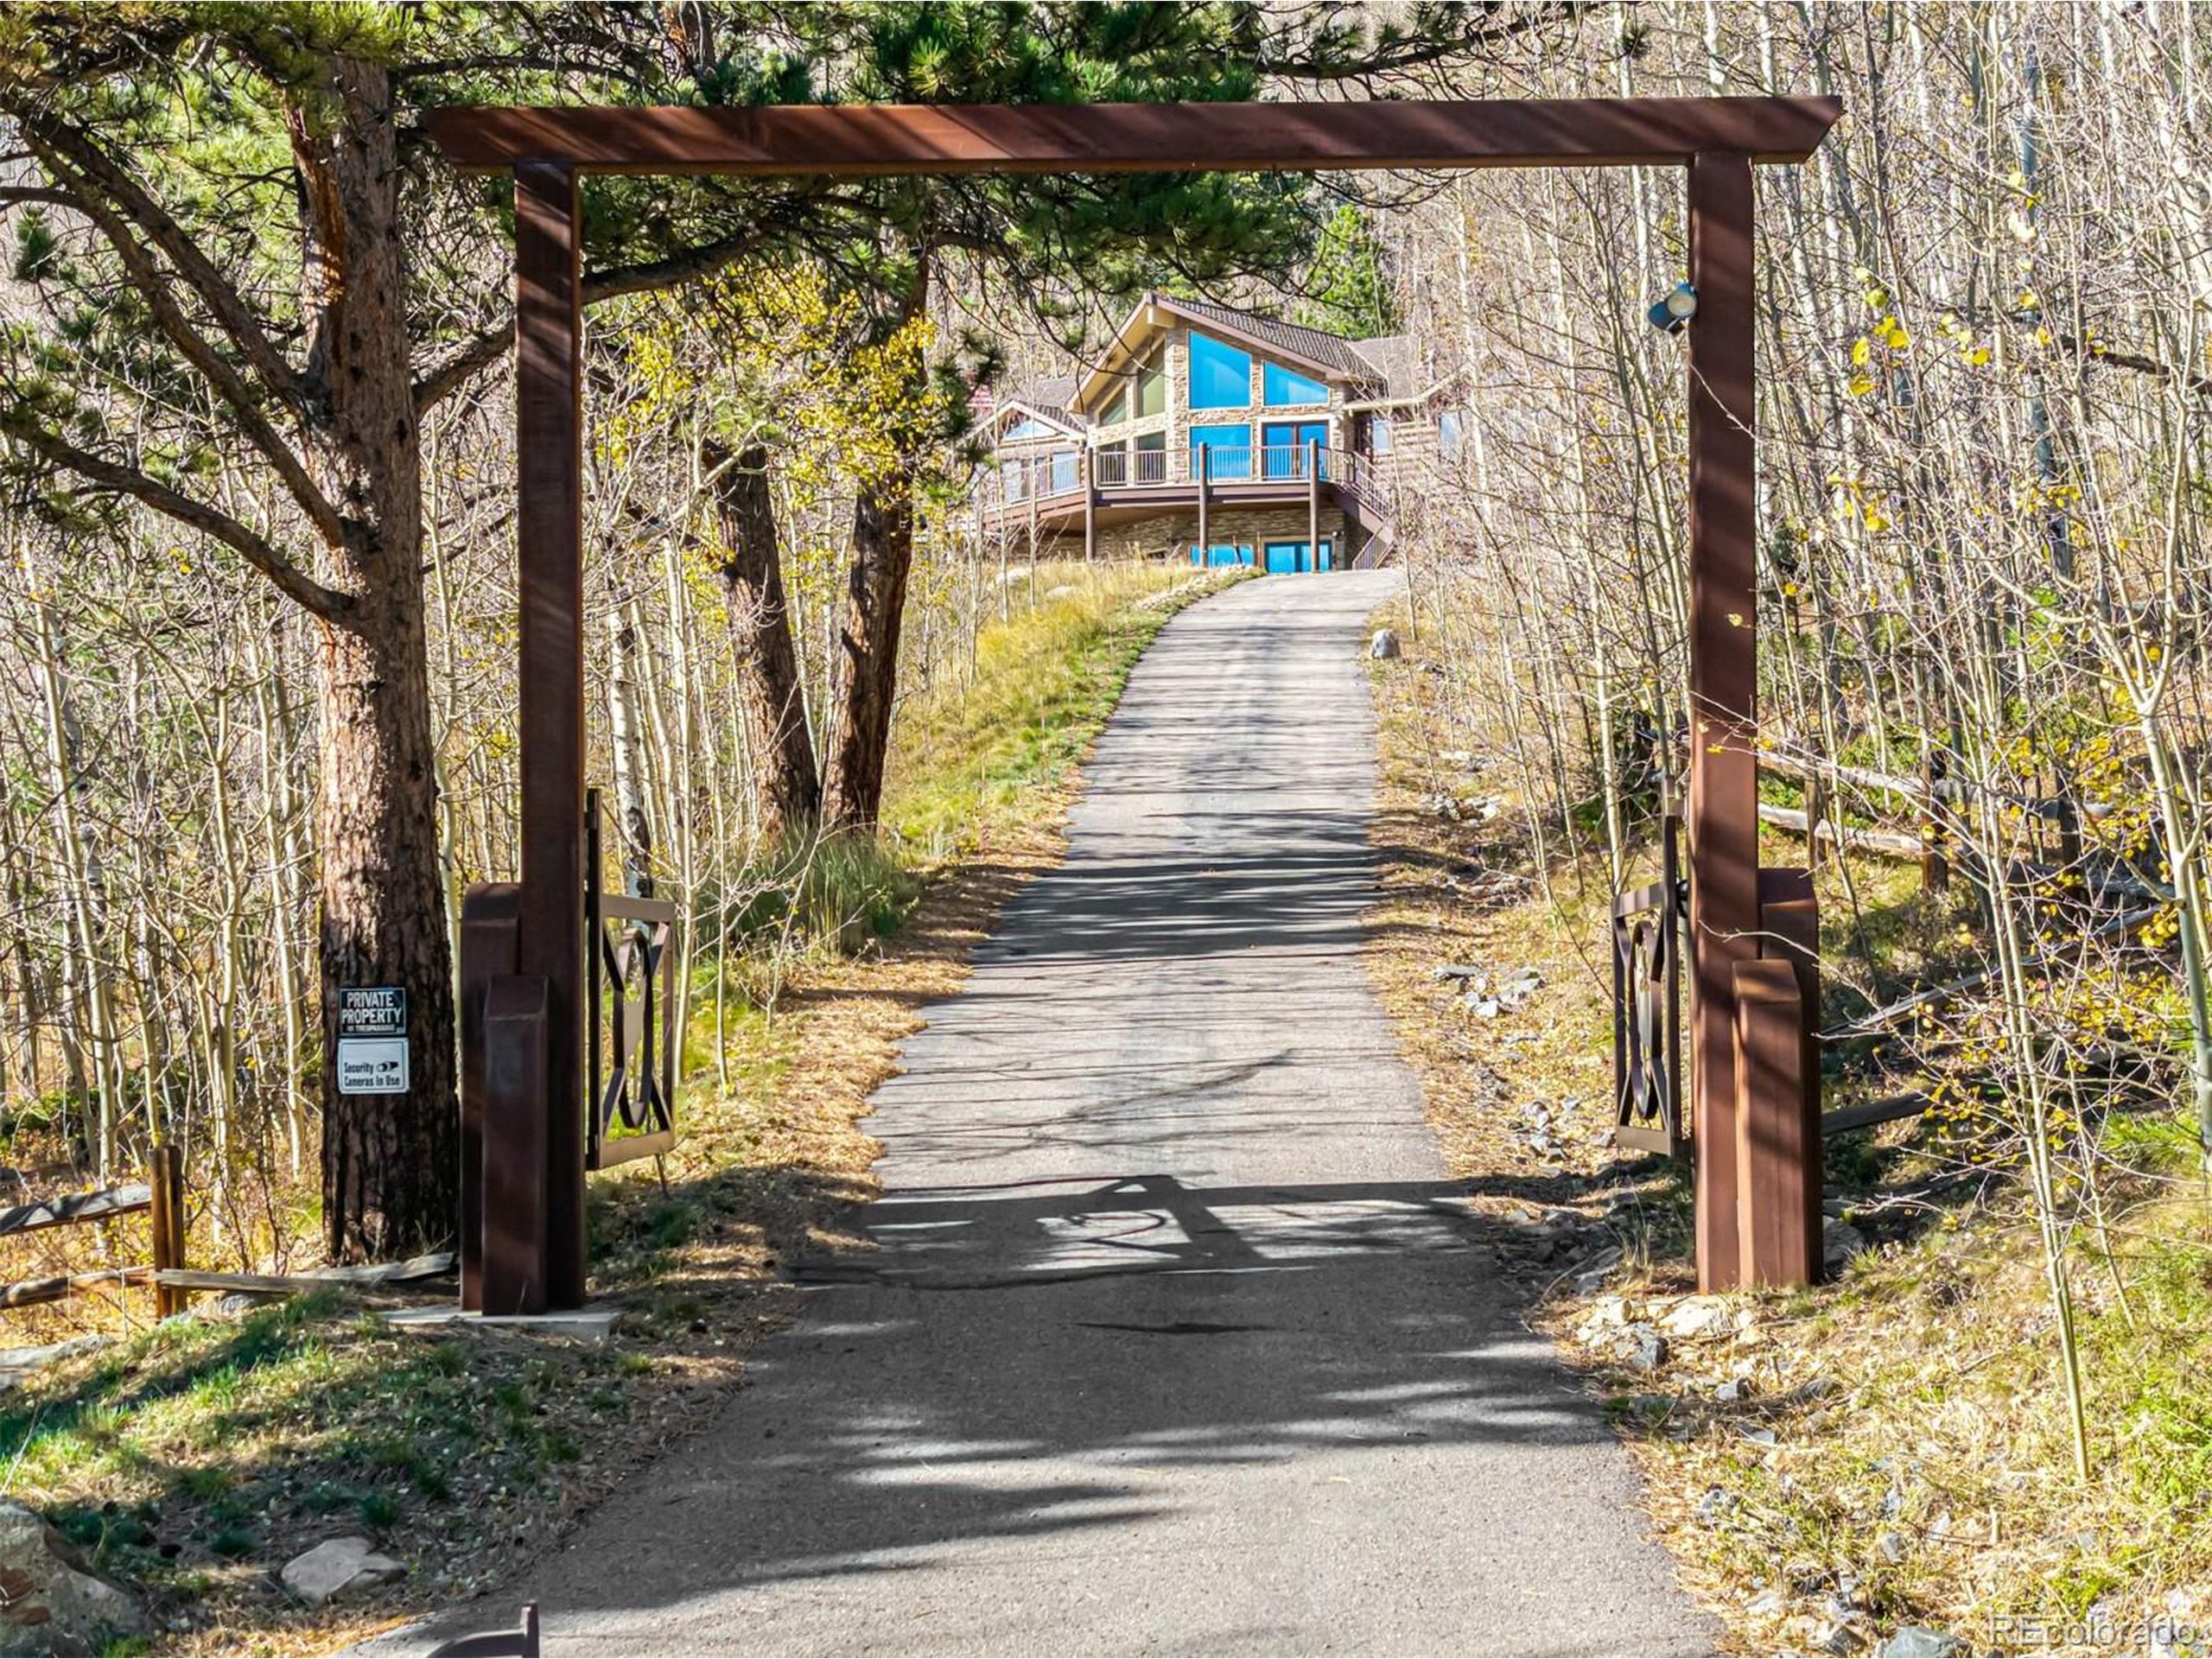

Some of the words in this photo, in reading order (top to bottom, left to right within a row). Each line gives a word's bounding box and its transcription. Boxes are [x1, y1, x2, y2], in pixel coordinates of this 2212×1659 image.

[347, 992, 394, 1007] PRIVATE
[341, 1007, 402, 1024] PROPERTY
[344, 1062, 374, 1075] Security
[344, 1076, 374, 1086] Cameras
[385, 1075, 400, 1086] Use
